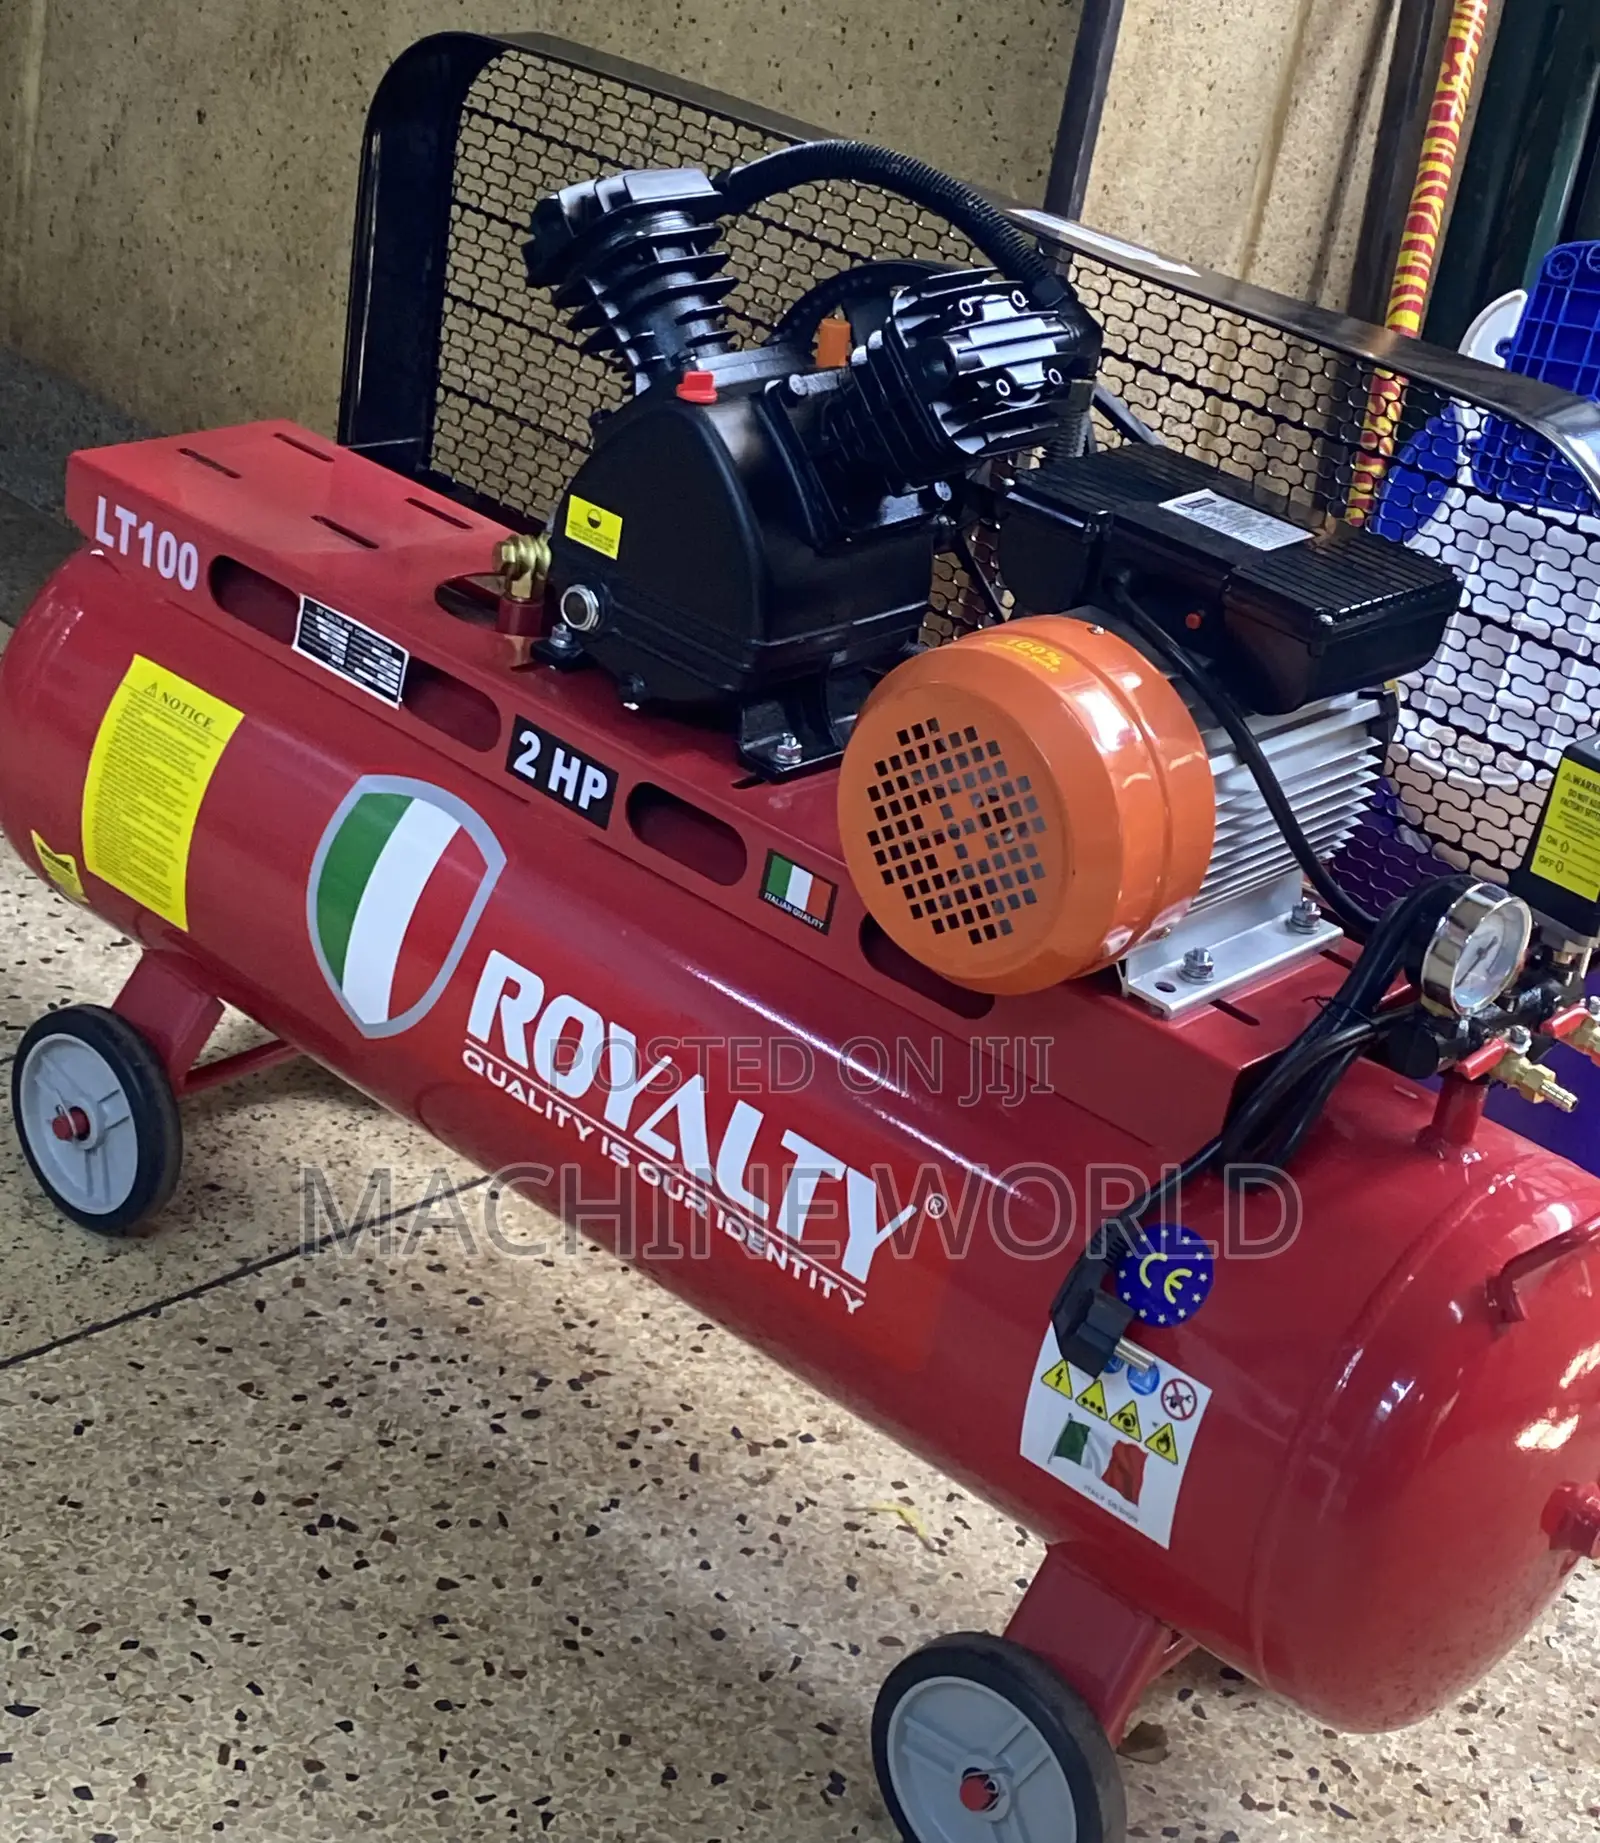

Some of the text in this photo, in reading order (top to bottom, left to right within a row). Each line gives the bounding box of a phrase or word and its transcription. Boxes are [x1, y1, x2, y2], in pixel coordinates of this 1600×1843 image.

[96, 495, 199, 591] LT100
[161, 692, 216, 730] NOTICE
[513, 730, 608, 810] 2 HP
[764, 892, 825, 930] ITALIAN QUALITY
[466, 949, 918, 1284] ROYALTY
[462, 1049, 865, 1315] QUALITY IS OUR IDENTITY
[1138, 1252, 1193, 1304] CE
